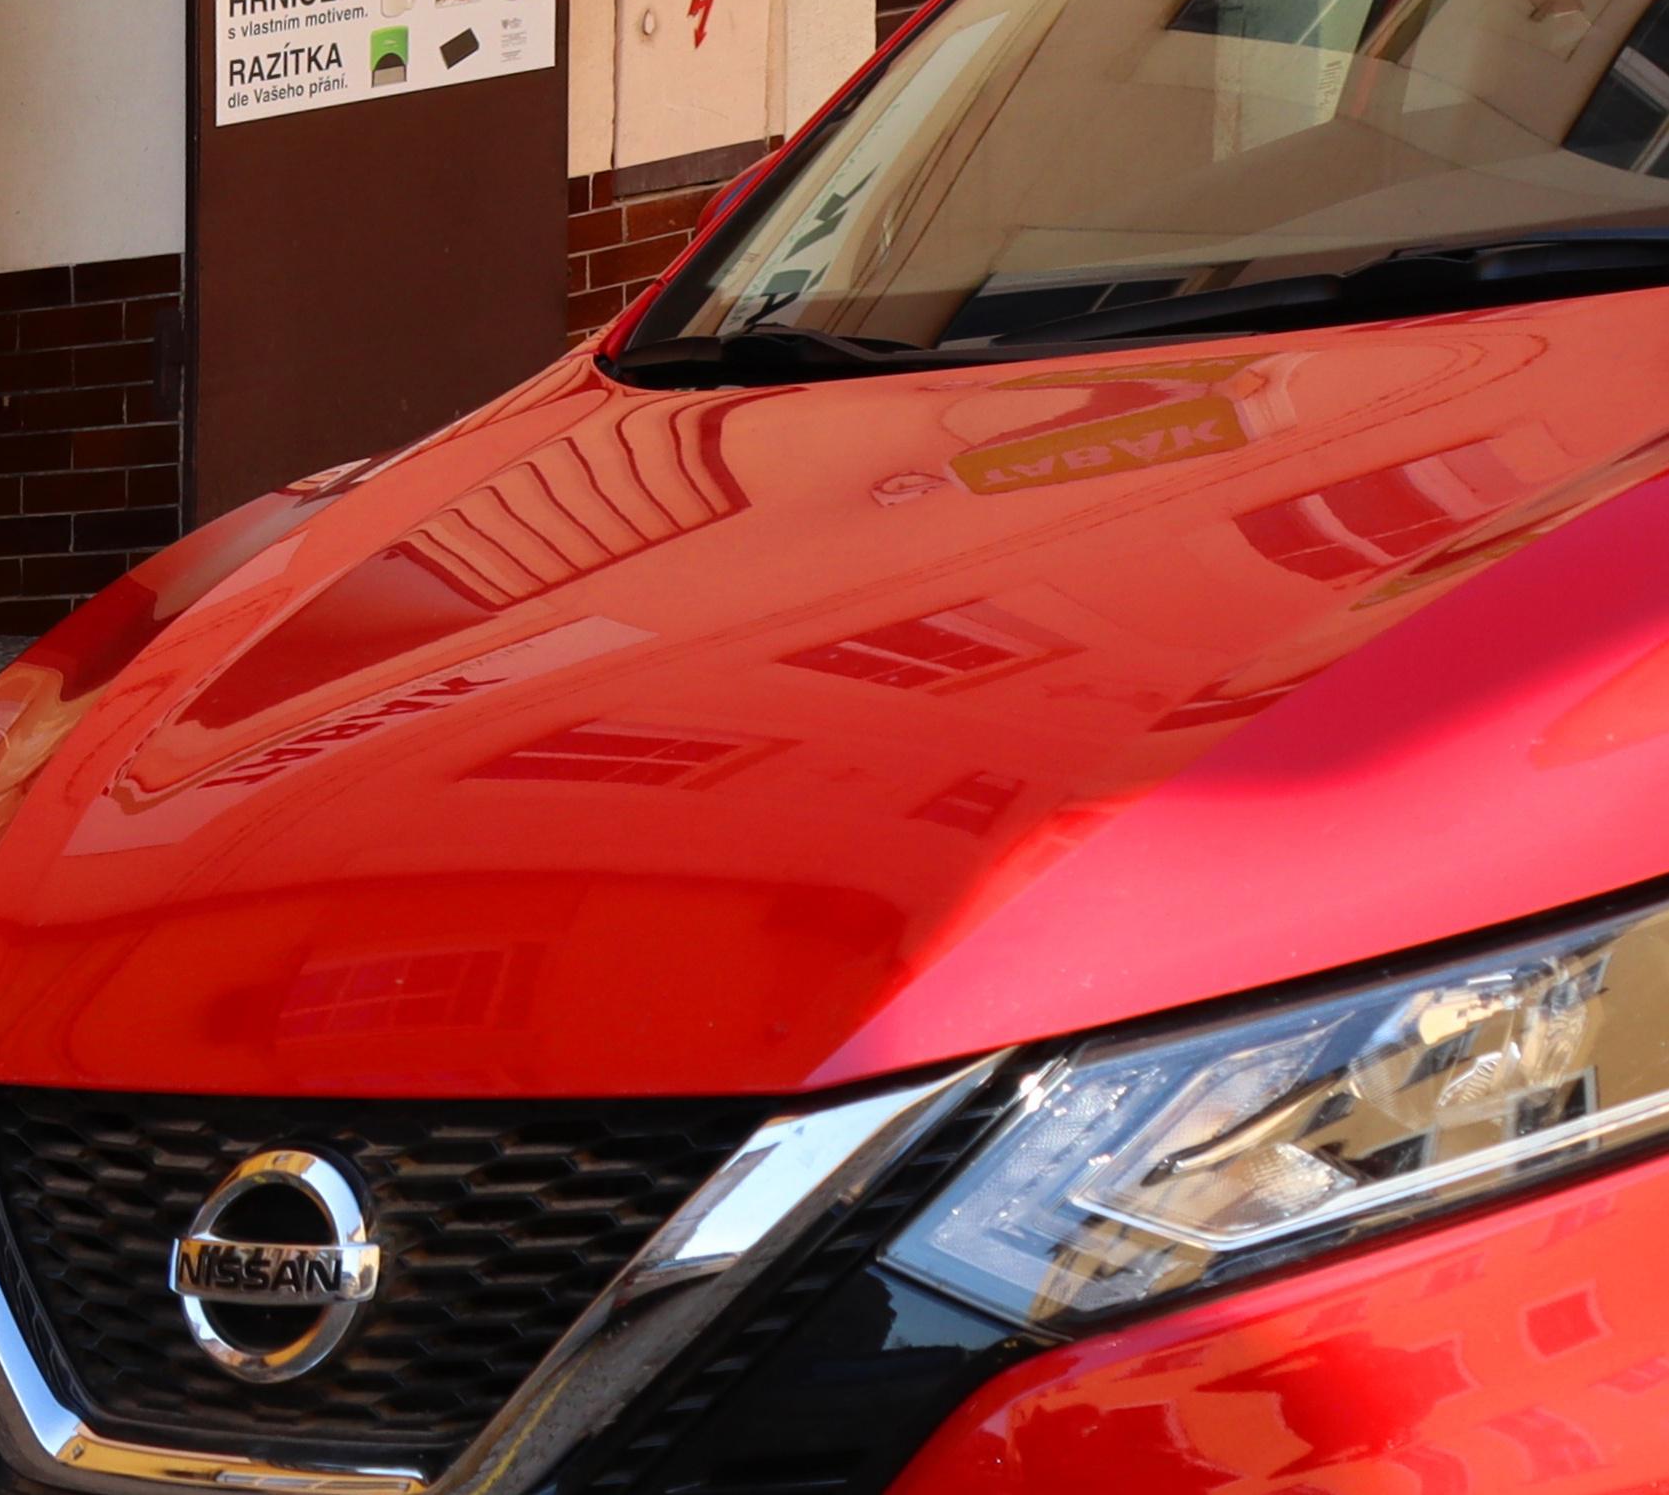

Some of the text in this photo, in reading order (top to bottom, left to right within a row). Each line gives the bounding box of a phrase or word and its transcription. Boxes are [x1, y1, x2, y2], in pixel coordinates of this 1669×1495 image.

[228, 6, 368, 39] s vlastním motivem.
[229, 42, 343, 87] RAZÍTKA
[228, 73, 349, 109] dle Vašeho přání.
[178, 1252, 342, 1293] NISSAN
